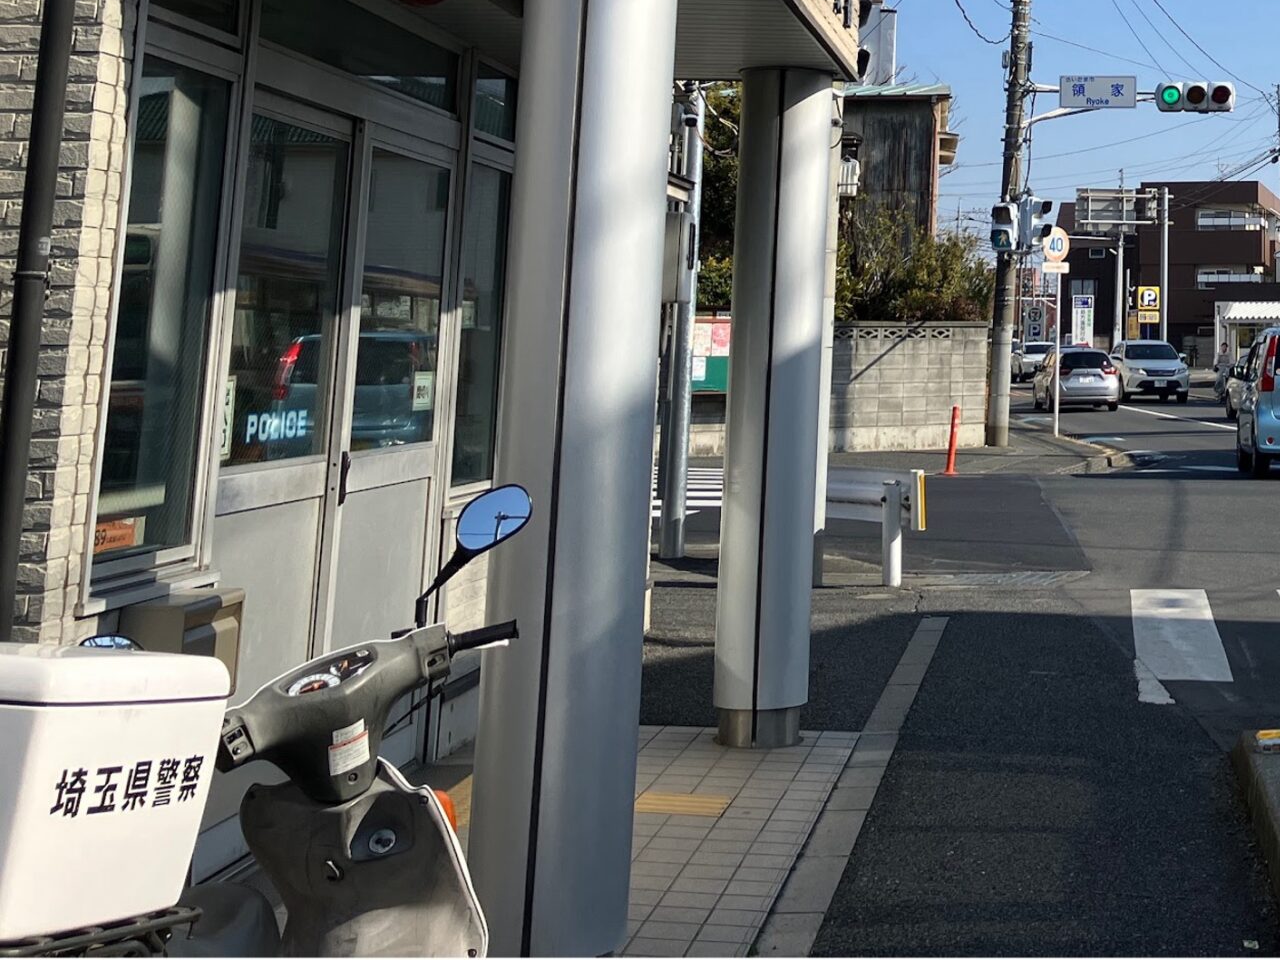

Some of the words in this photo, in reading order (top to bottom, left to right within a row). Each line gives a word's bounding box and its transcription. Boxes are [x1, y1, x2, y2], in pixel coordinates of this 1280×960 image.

[1086, 97, 1110, 106] Ryoke
[1049, 236, 1064, 252] 40
[1143, 290, 1156, 306] P
[246, 410, 308, 444] POLICE
[50, 754, 205, 818] 埼玉県警察
